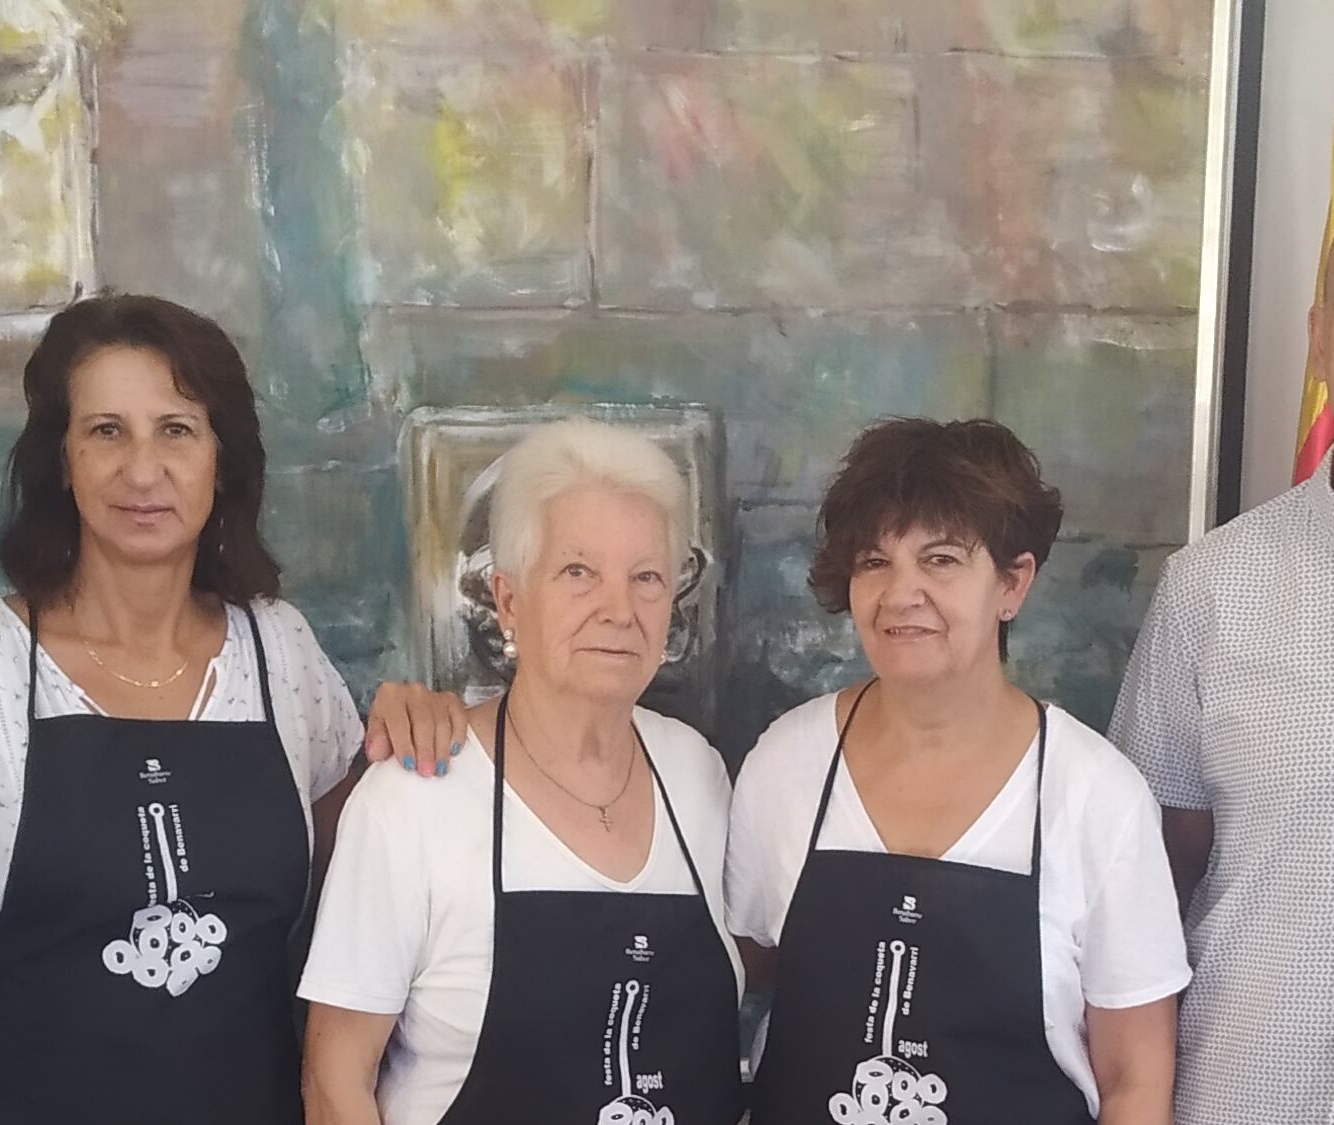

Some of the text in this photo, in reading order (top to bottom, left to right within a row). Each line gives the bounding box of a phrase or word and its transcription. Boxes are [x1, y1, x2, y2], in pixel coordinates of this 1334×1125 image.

[137, 806, 150, 850] coqueta
[874, 941, 886, 985] coqueta
[607, 983, 621, 1026] coqueta
[898, 1039, 928, 1058] agost
[636, 1071, 663, 1094] agost
